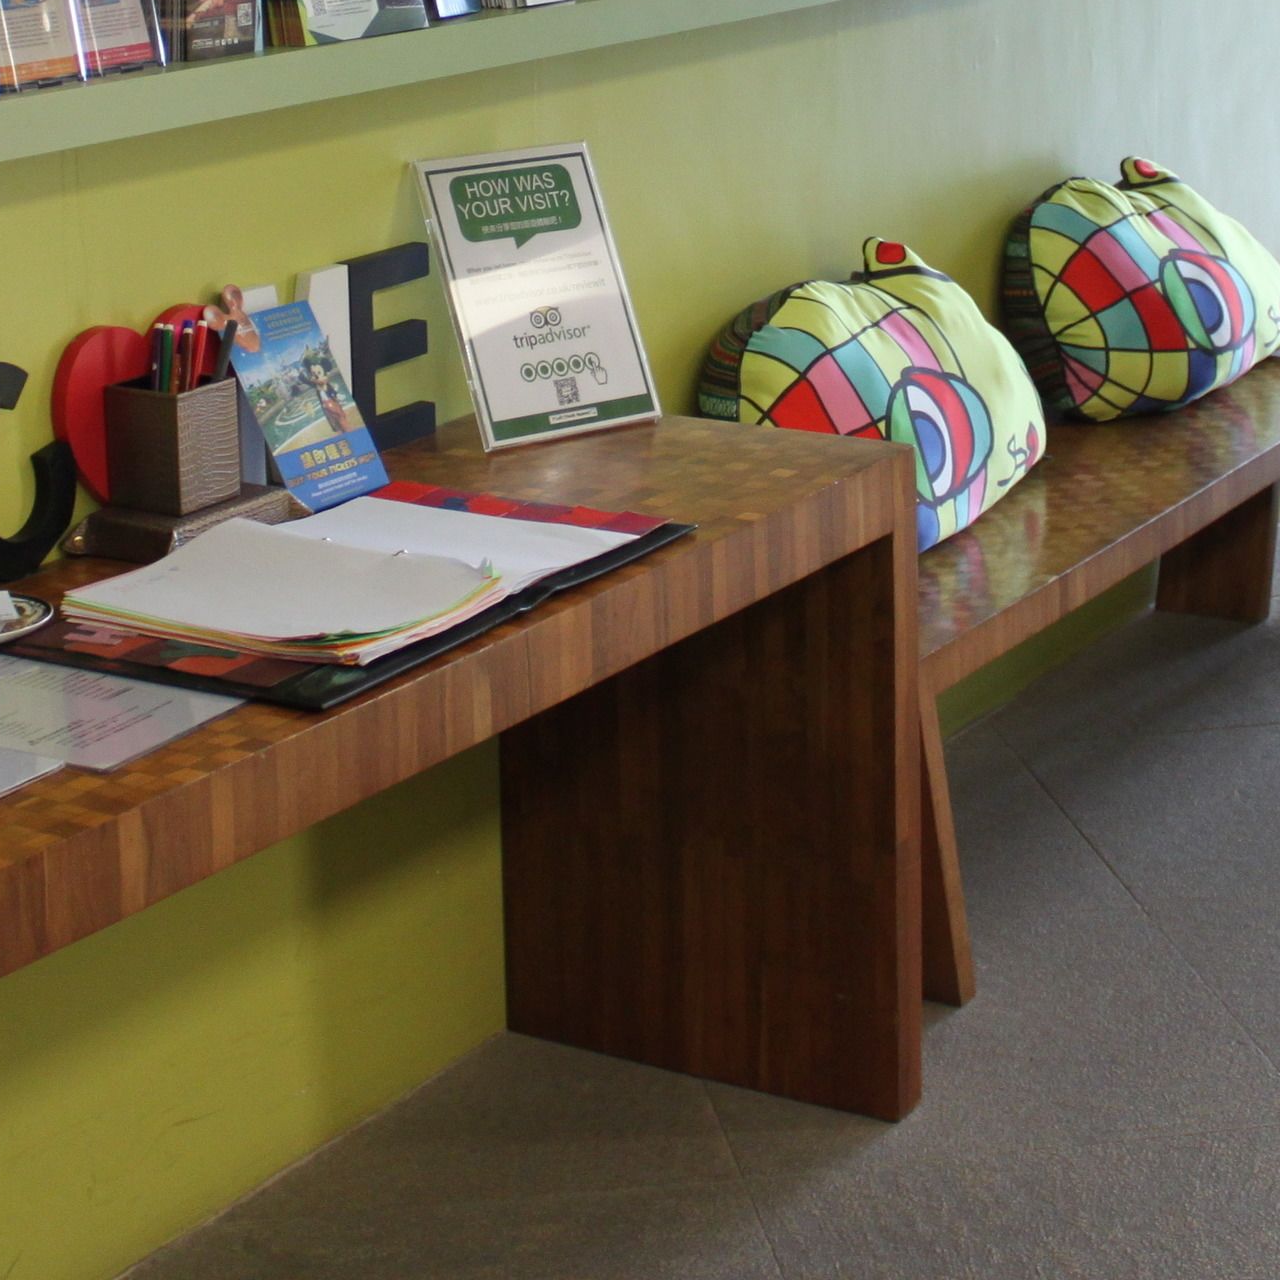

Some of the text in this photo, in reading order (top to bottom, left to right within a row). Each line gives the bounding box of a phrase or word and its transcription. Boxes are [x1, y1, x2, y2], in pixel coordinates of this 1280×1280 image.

[464, 171, 556, 200] HOW WAS
[457, 189, 571, 220] YOUR VISIT?
[513, 325, 587, 350] tripadvisor
